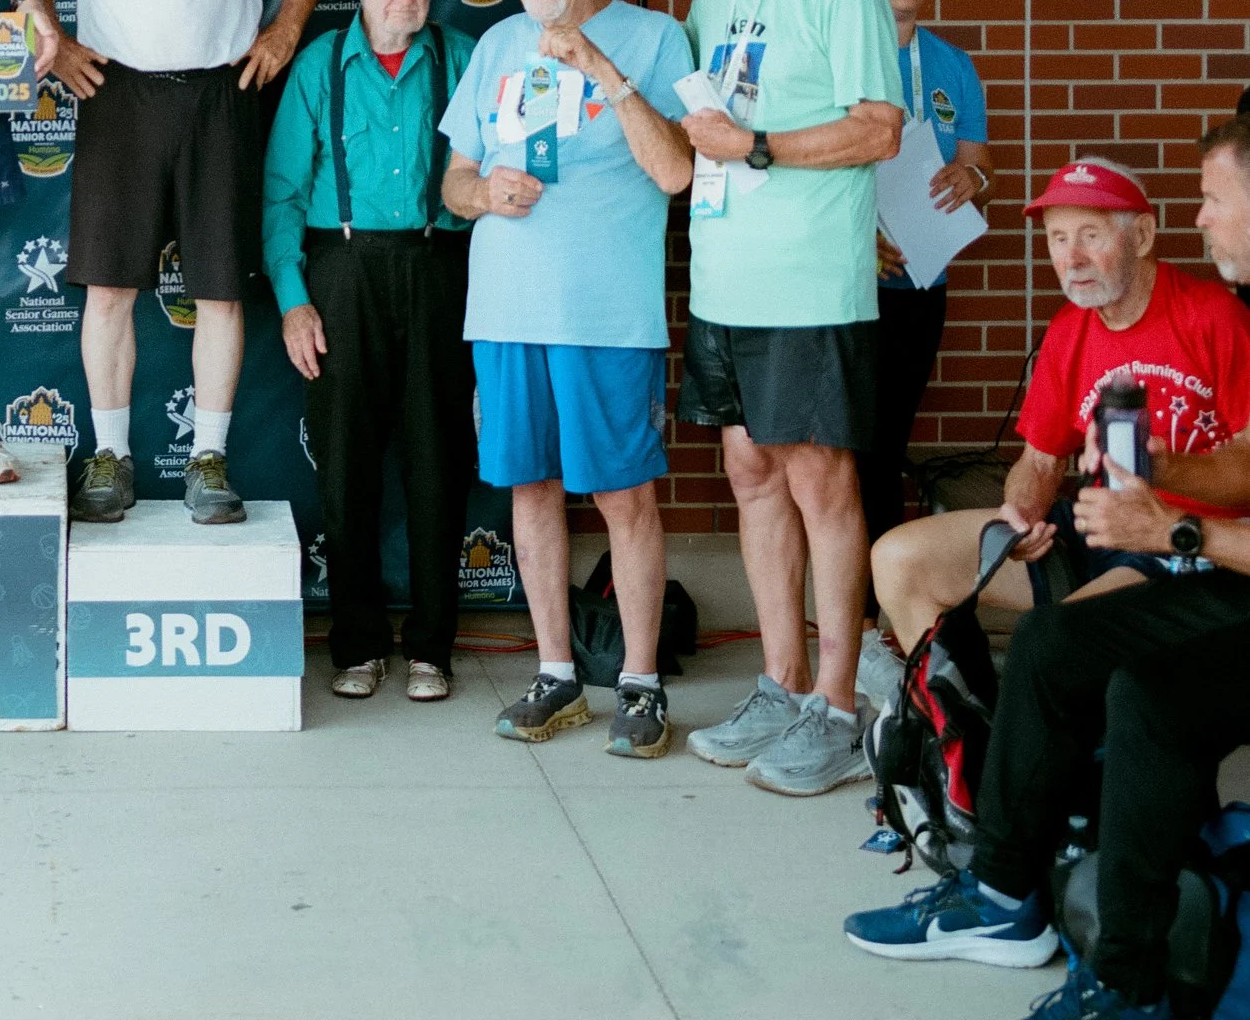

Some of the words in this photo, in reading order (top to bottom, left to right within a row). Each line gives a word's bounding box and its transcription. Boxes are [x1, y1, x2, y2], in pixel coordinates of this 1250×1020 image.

[56, 106, 73, 119] '25
[11, 120, 76, 132] NATIONAL
[19, 296, 65, 306] National
[5, 309, 39, 320] Senior
[42, 309, 78, 320] Games
[11, 322, 73, 332] Association
[1132, 360, 1184, 384] Running
[1184, 375, 1213, 398] Club
[51, 414, 69, 425] '25
[7, 425, 74, 437] NATIONAL
[154, 456, 187, 466] Senior
[490, 555, 506, 565] '25
[459, 568, 511, 578] ATIONAL
[480, 578, 512, 587] GAMES
[464, 592, 495, 600] Humana
[125, 613, 251, 667] 3RD
